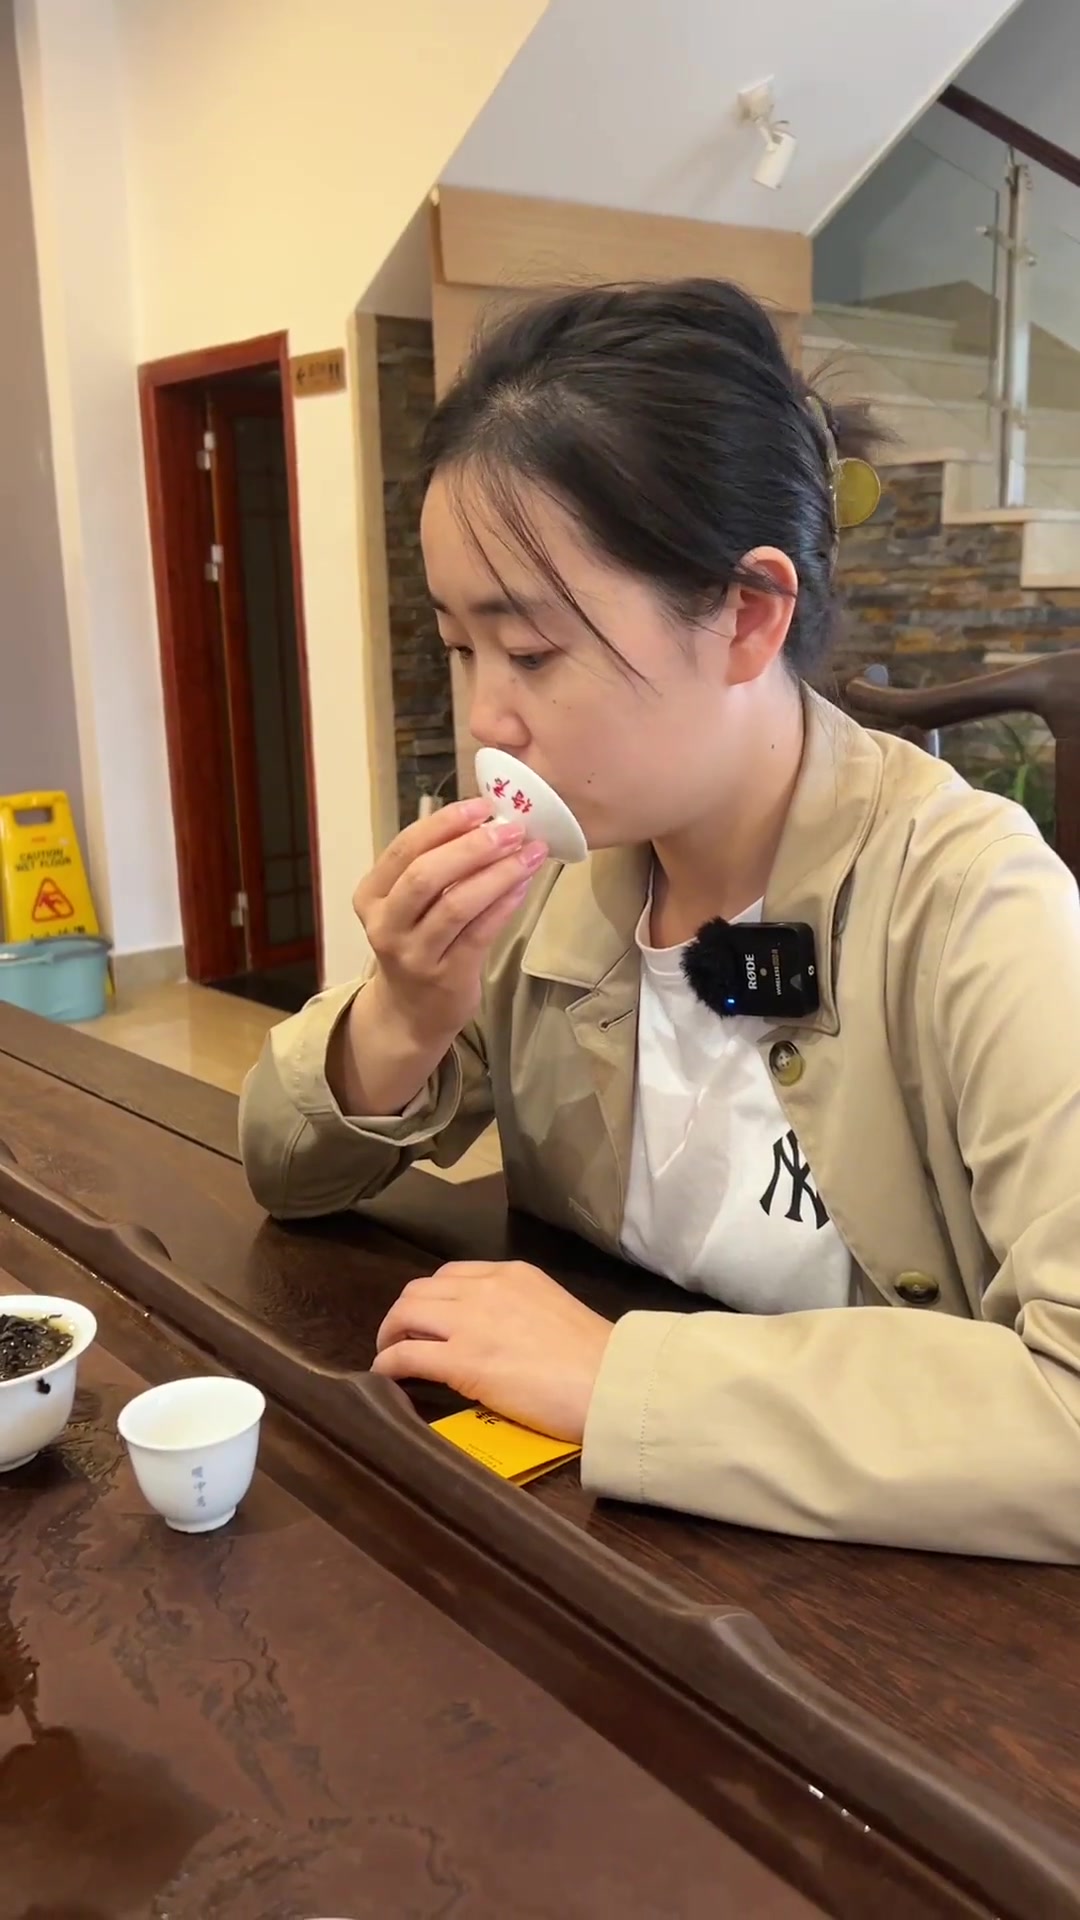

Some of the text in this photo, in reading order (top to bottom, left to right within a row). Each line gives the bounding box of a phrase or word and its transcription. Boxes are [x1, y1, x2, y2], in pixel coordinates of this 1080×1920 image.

[19, 848, 64, 861] CAUTION
[15, 856, 72, 872] WET FLOOR
[744, 953, 758, 990] RØDE
